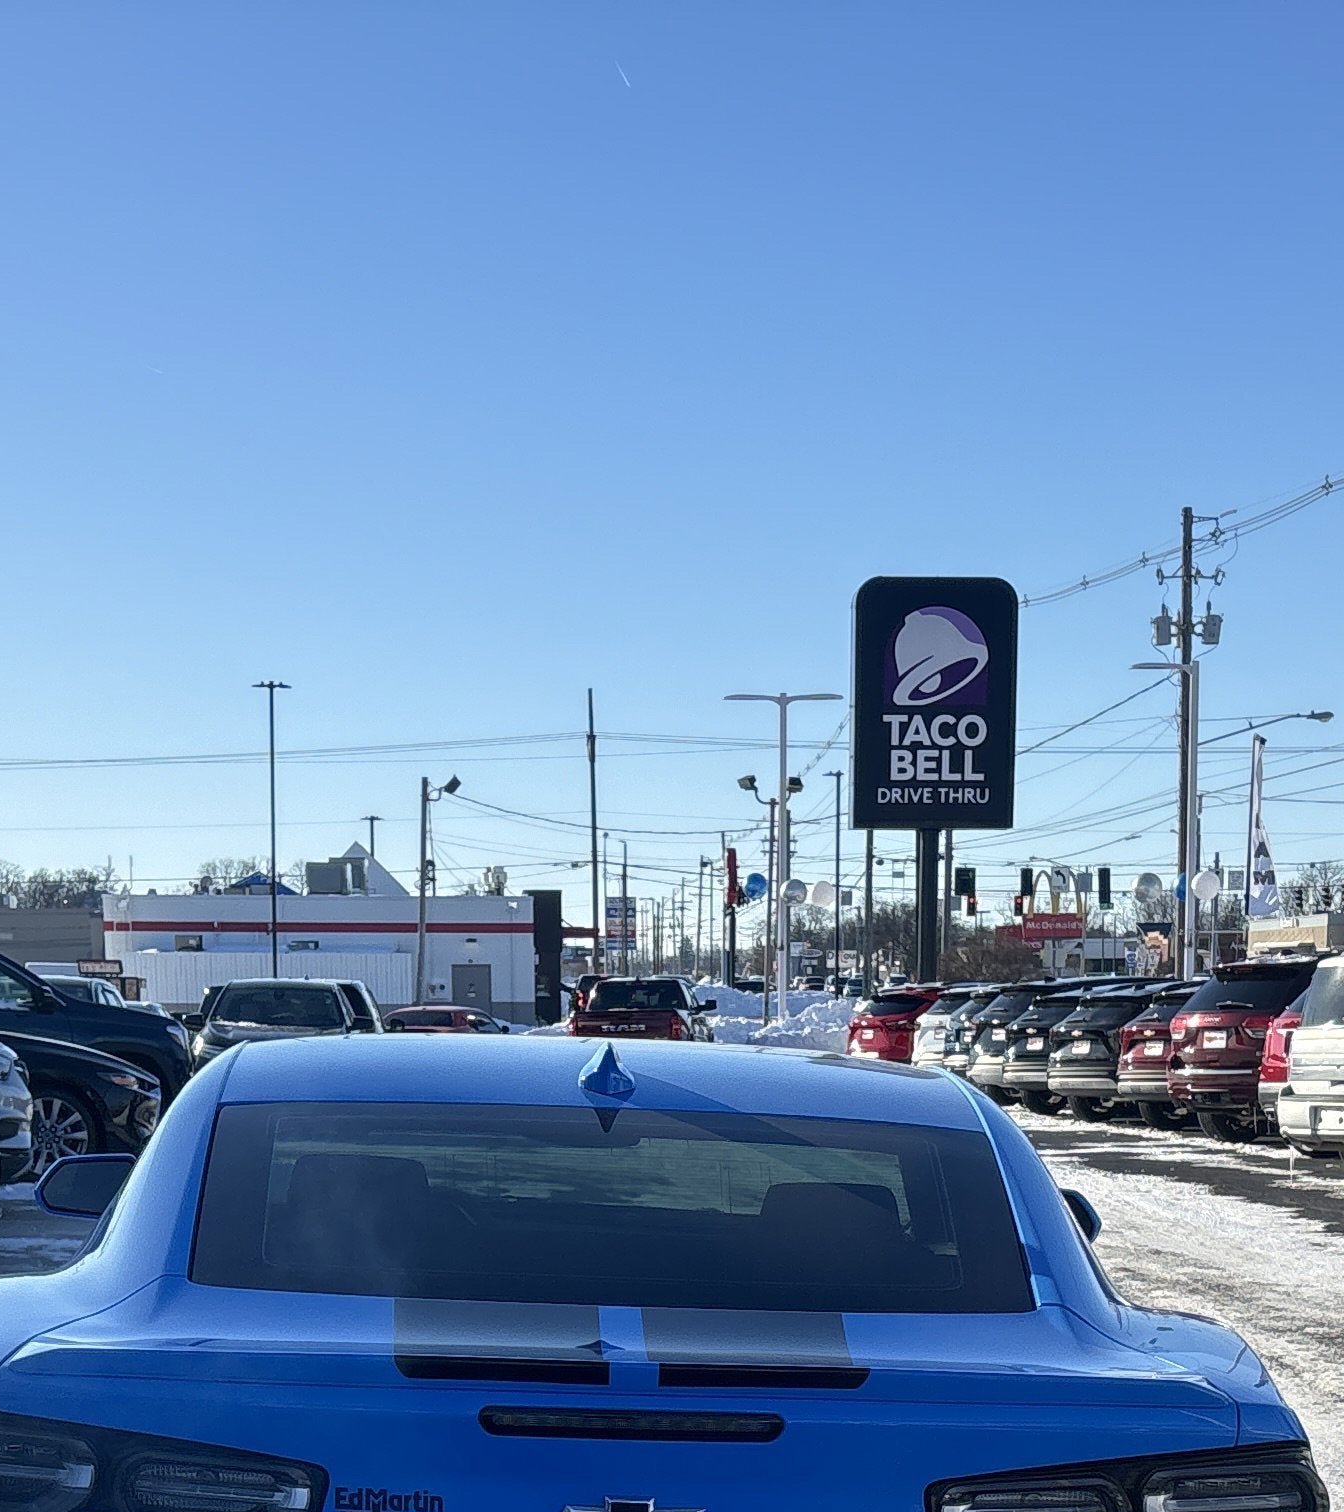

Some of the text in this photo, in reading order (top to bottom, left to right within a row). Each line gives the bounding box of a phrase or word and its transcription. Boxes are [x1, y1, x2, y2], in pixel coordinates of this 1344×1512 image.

[882, 714, 988, 747] TACO
[890, 749, 985, 782] BELL
[877, 787, 990, 804] DRIVE THRU
[1025, 920, 1083, 930] McDonald's
